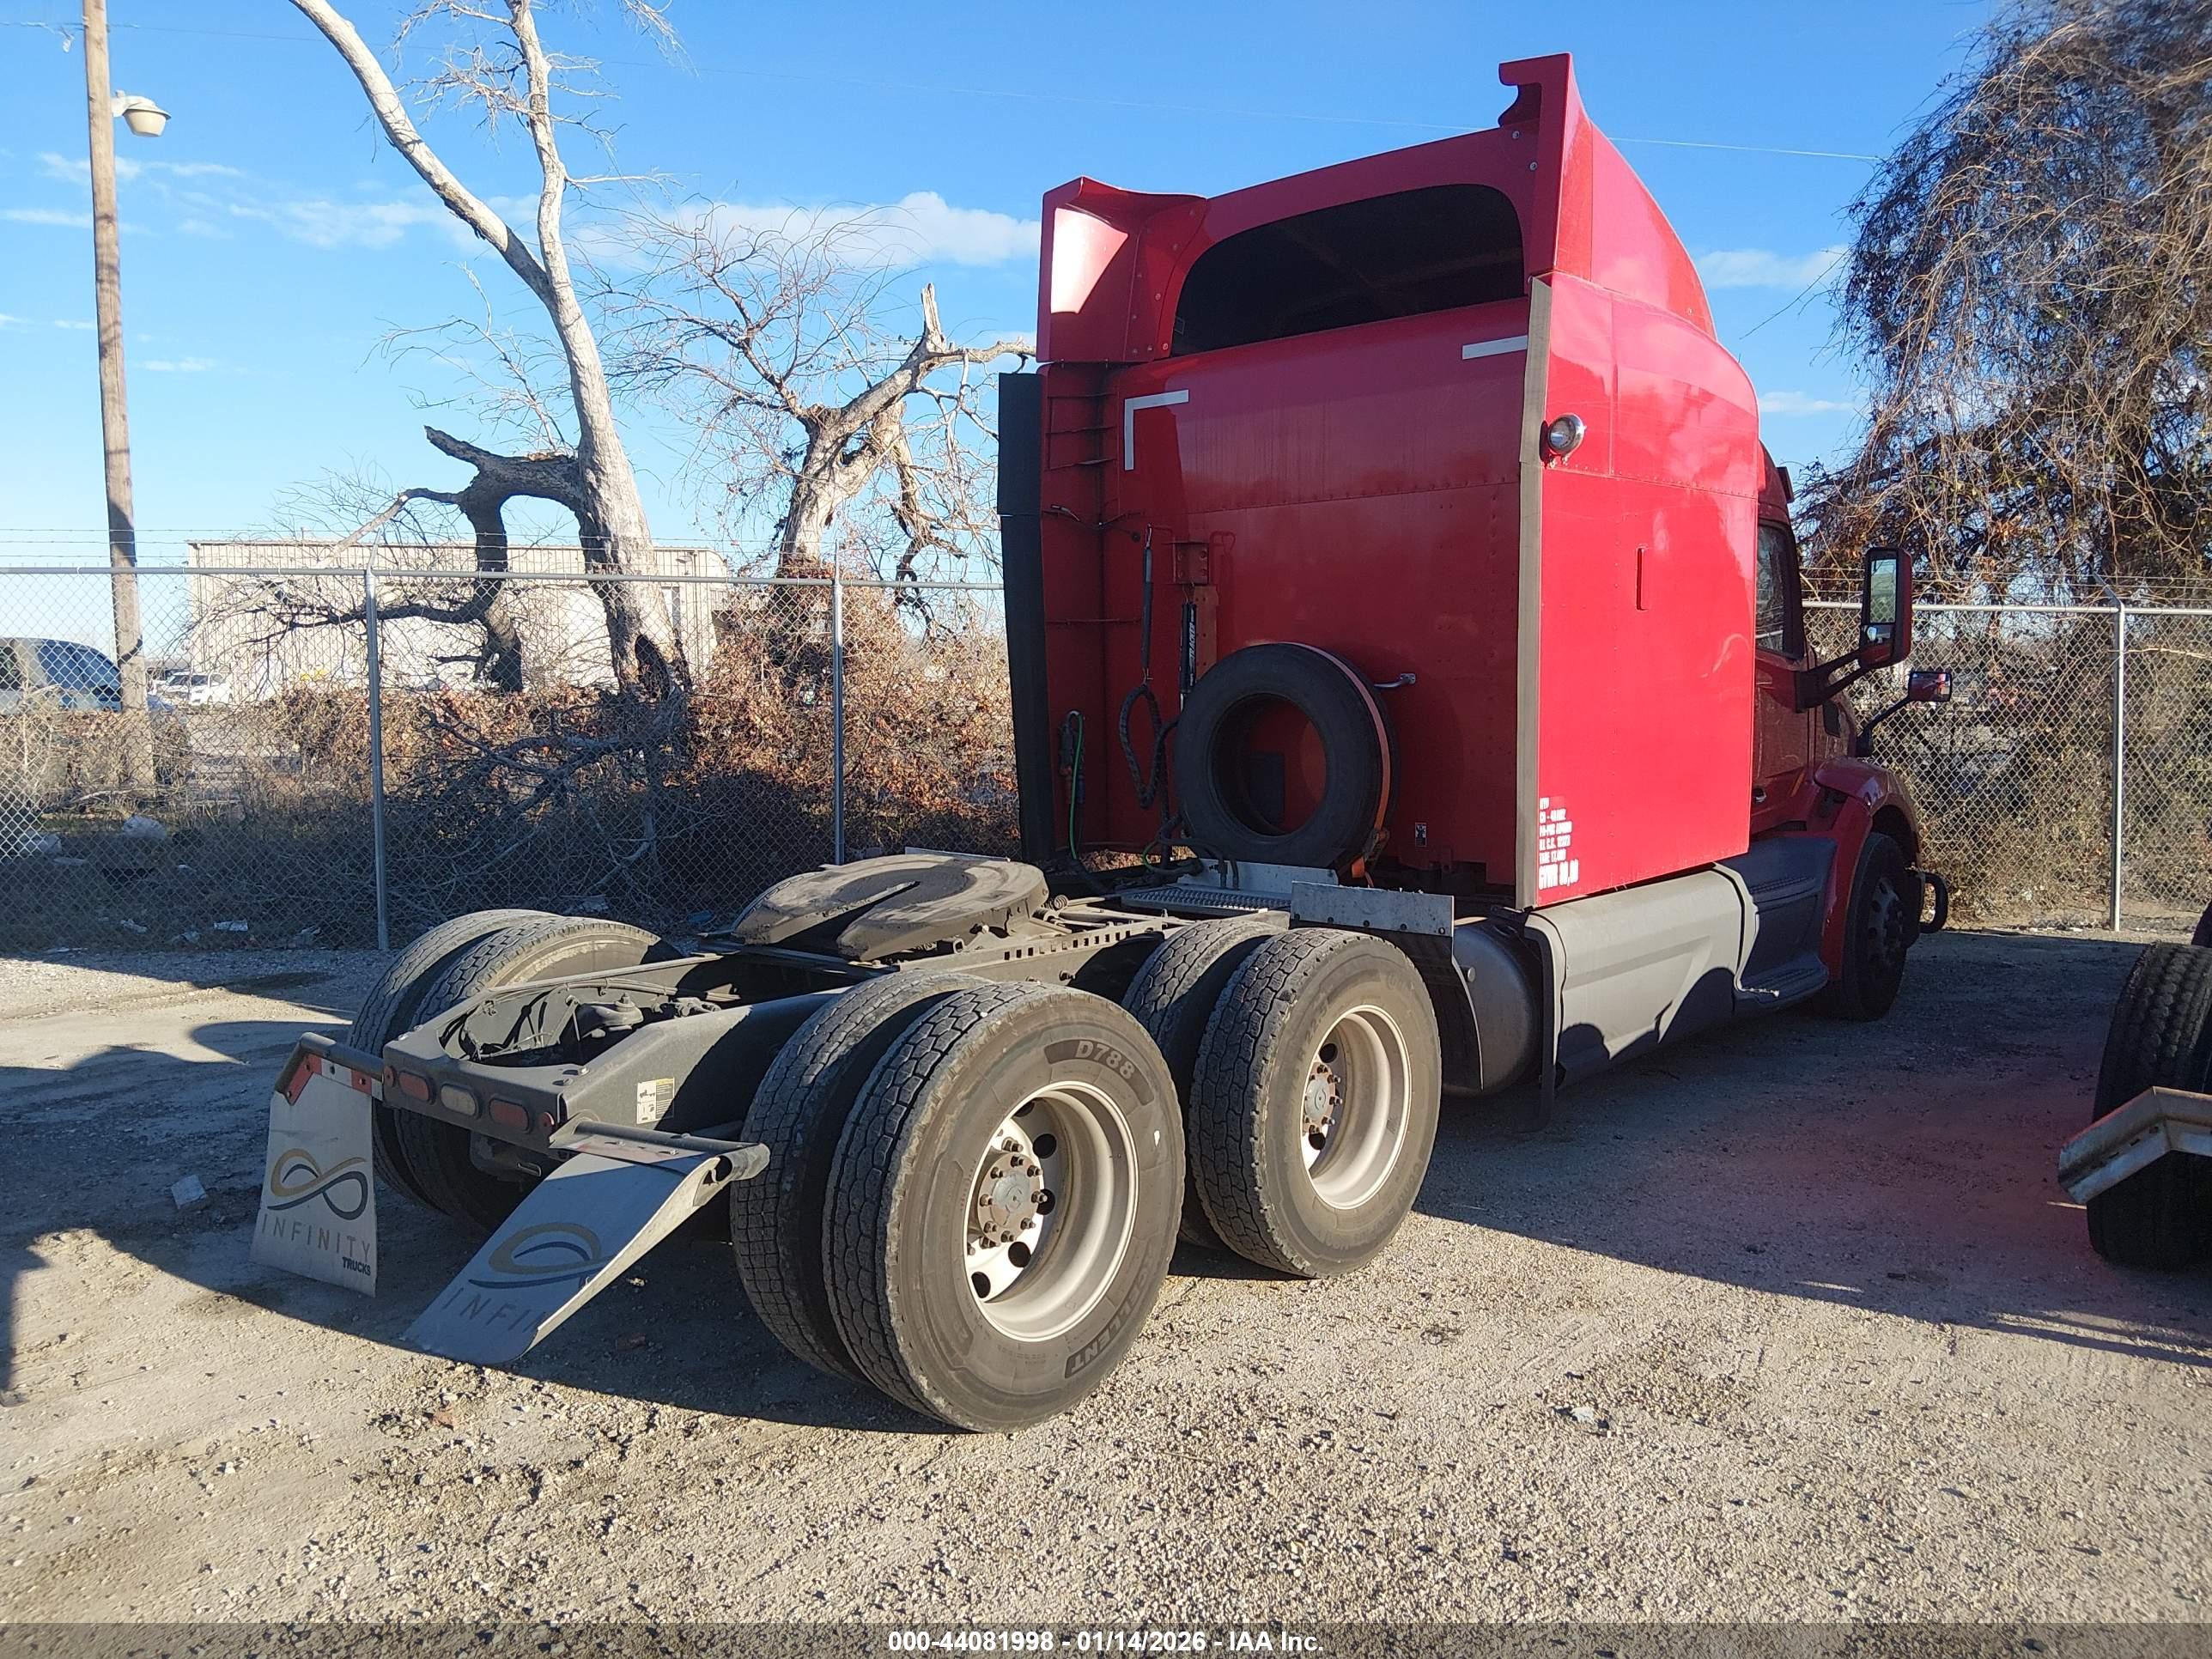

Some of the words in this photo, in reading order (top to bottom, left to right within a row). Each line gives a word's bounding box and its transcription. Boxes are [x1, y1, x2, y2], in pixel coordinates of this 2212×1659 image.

[1074, 1040, 1135, 1079] D788
[261, 1213, 370, 1262] INFINITY
[343, 1256, 371, 1276] TRUCKS
